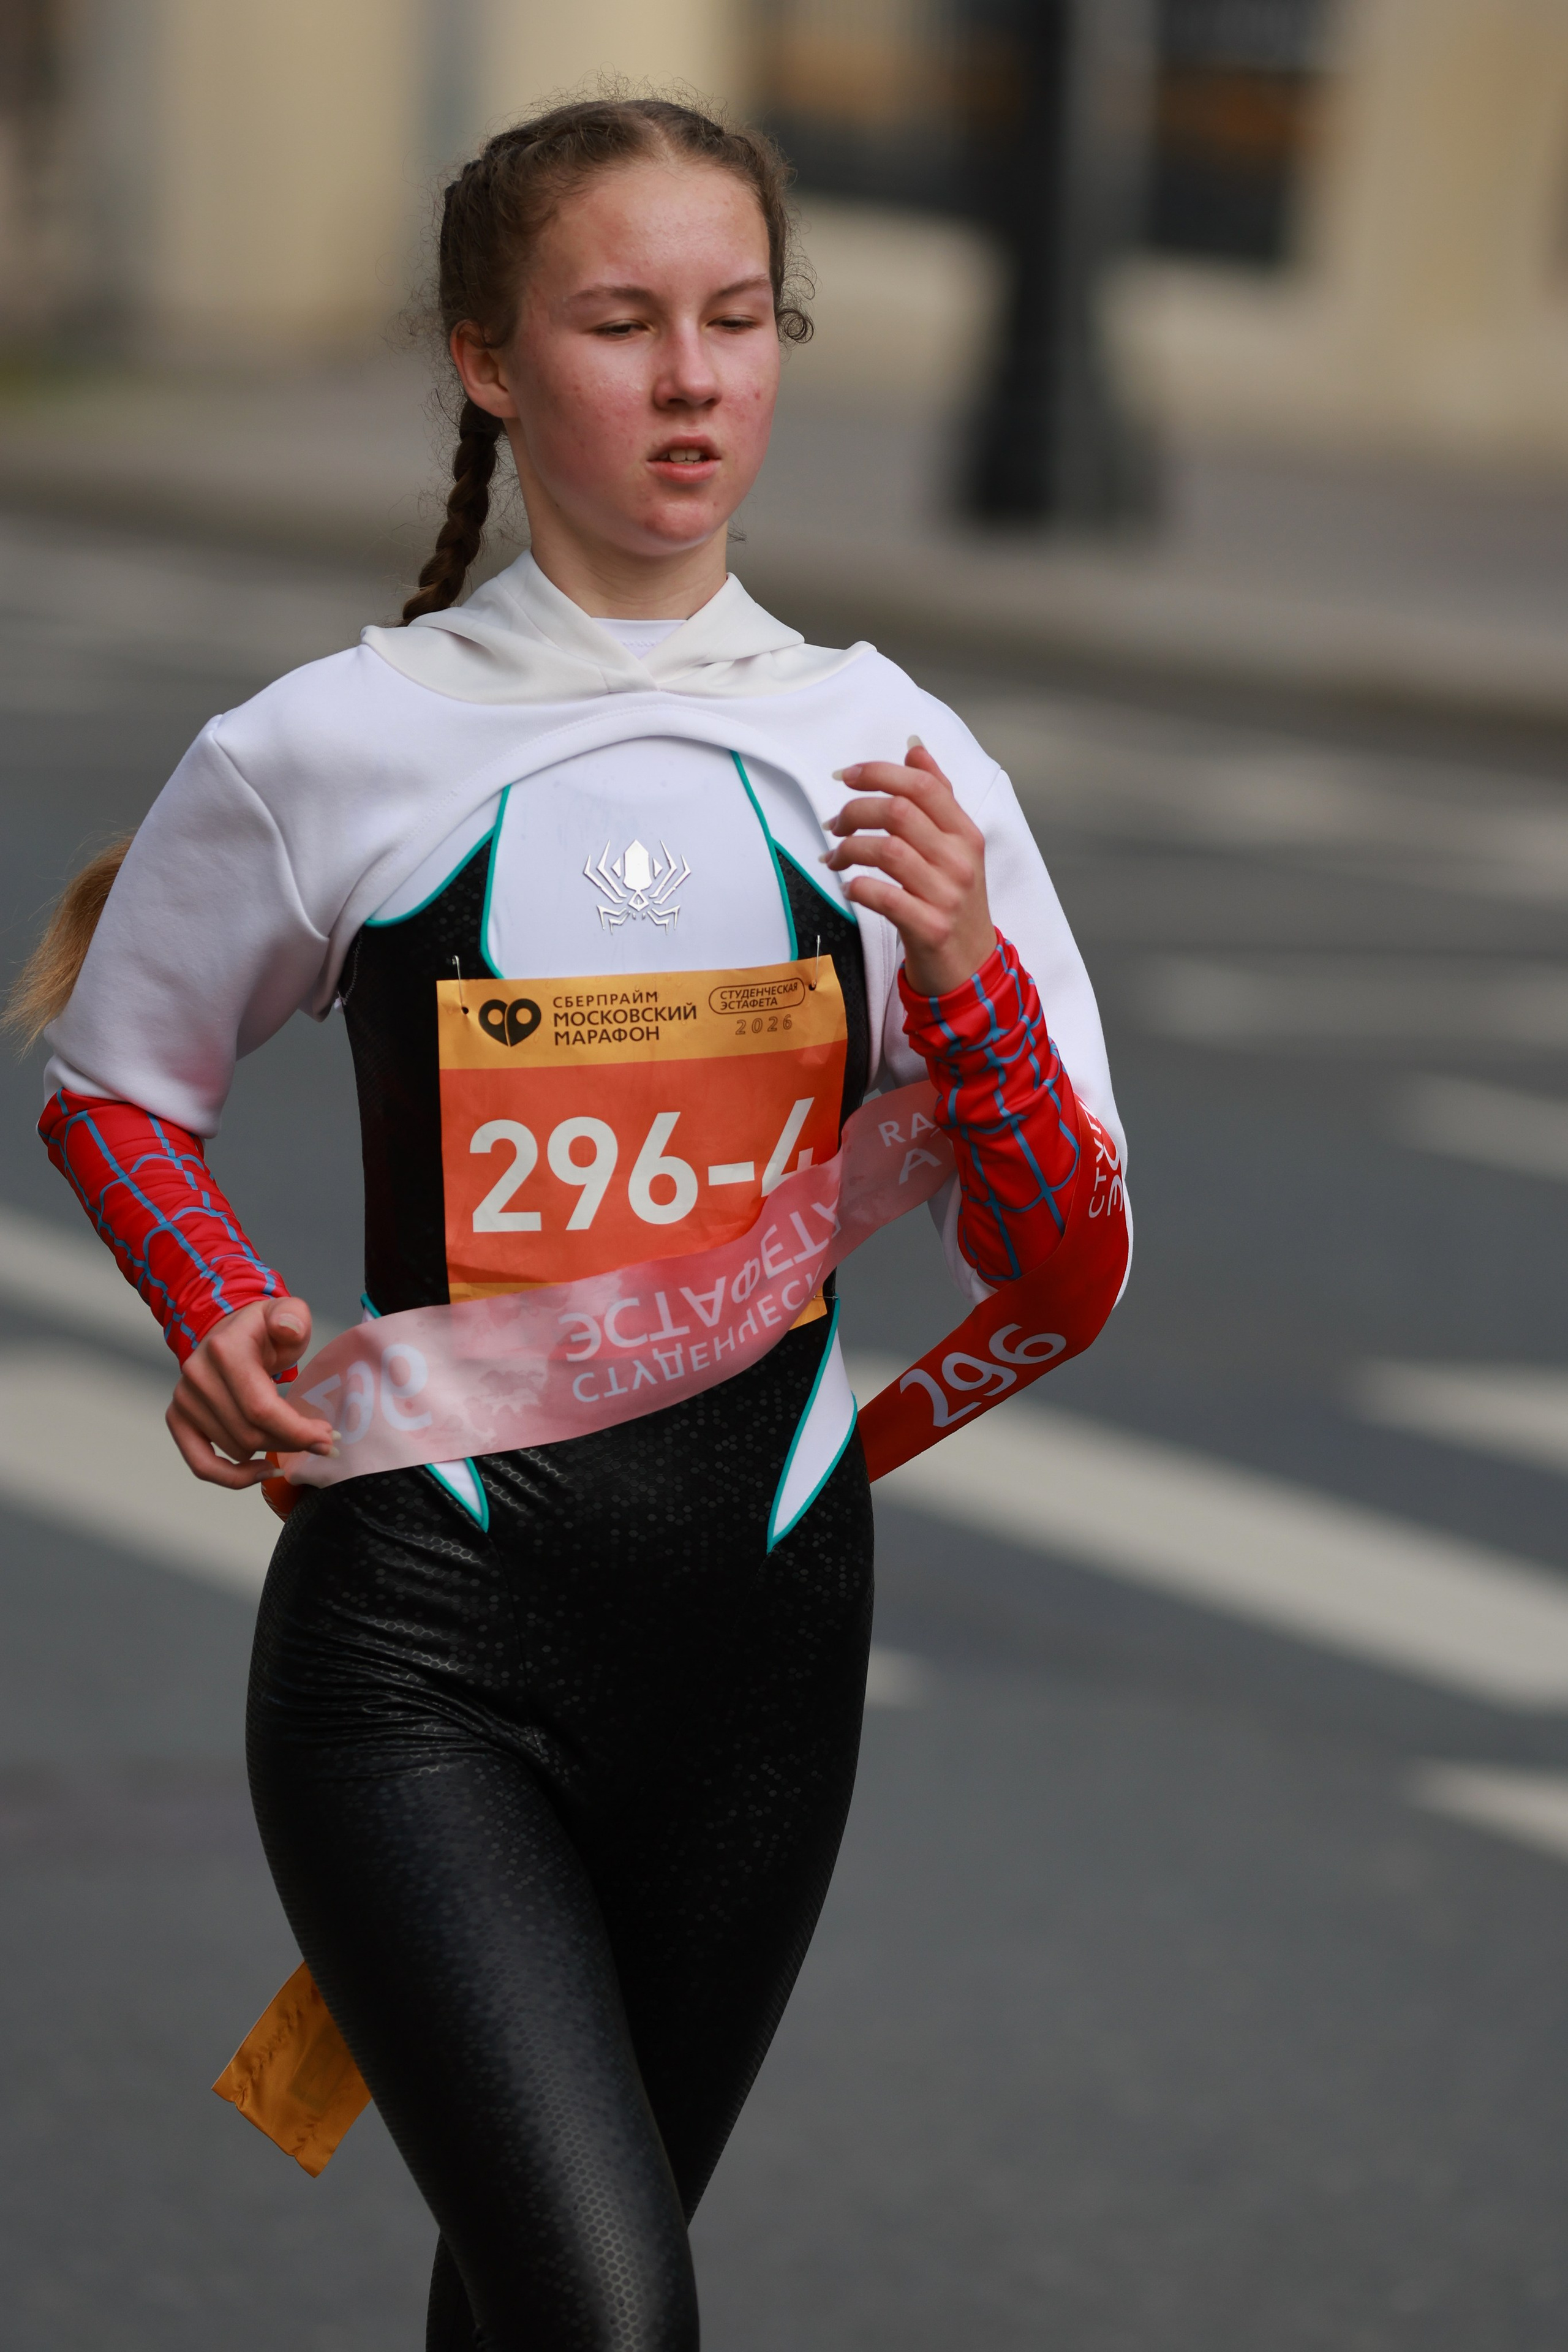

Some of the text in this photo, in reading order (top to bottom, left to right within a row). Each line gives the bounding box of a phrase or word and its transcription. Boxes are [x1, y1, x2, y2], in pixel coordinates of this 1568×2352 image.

[553, 990, 658, 1008] СБЕРПРАЙМ
[720, 982, 797, 1000] СТУДЕНЧЕСКАЯ
[720, 997, 778, 1011] ЭСТАФЕТА
[554, 1003, 697, 1027] МОСКОВСКИЙ
[735, 1014, 793, 1035] 2026
[554, 1027, 660, 1046] МАРАФОН
[469, 1097, 815, 1233] 296-4
[899, 1324, 1066, 1428] 296
